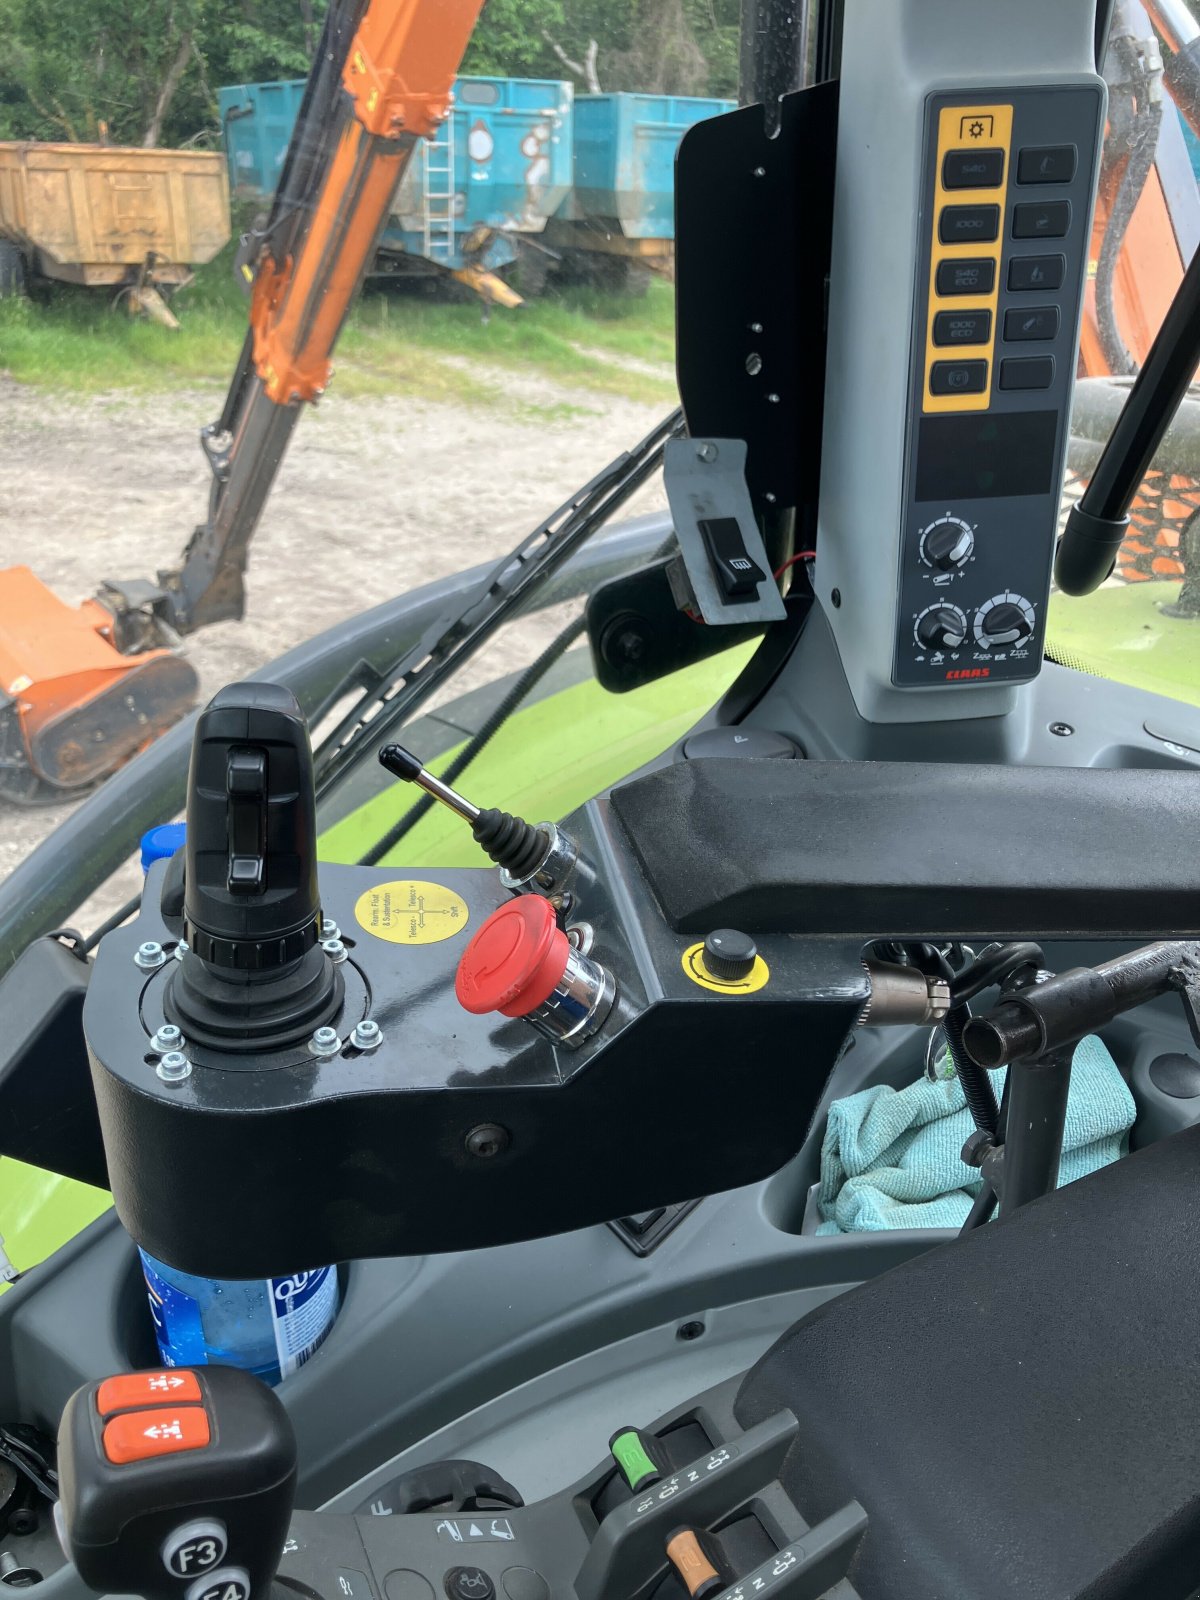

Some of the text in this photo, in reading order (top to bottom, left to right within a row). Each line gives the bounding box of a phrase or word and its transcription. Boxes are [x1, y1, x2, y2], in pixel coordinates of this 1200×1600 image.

[961, 165, 986, 174] 540
[955, 220, 983, 228] 1000
[955, 278, 977, 287] ECO
[945, 667, 991, 680] CLAAS
[275, 1268, 316, 1300] QU
[179, 1540, 217, 1573] F3
